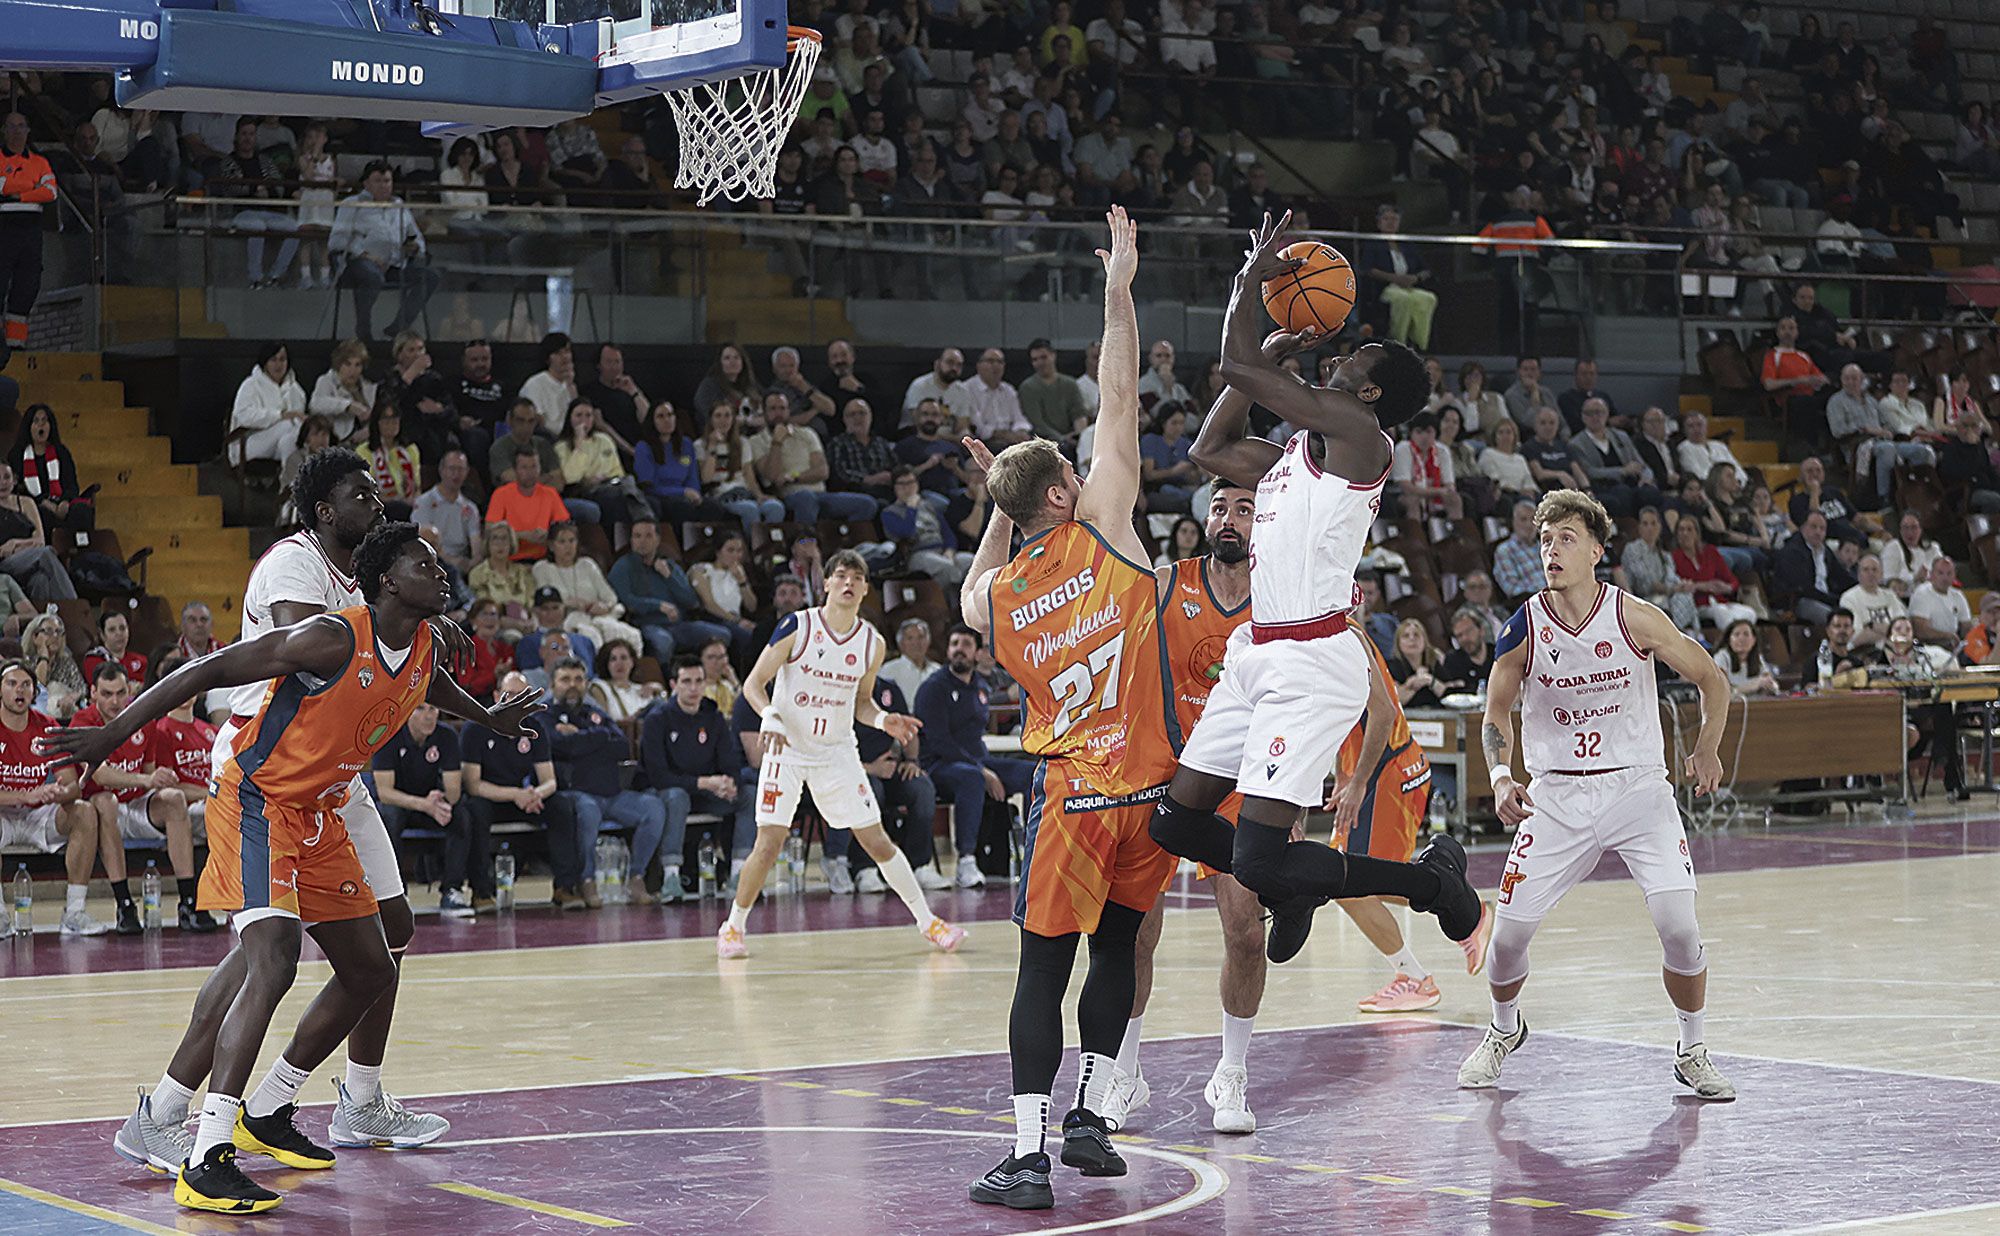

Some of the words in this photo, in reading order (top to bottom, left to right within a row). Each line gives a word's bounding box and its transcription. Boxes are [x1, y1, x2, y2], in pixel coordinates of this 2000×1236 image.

[119, 18, 158, 40] MO
[331, 60, 424, 86] MONDO
[1009, 565, 1097, 632] BURGOS
[1023, 593, 1121, 669] Wheyland
[1048, 627, 1126, 740] 27
[1555, 675, 1588, 688] CAJA
[1588, 666, 1631, 684] RURAL
[813, 717, 828, 737] 11
[1573, 731, 1602, 759] 32
[767, 761, 781, 780] 11
